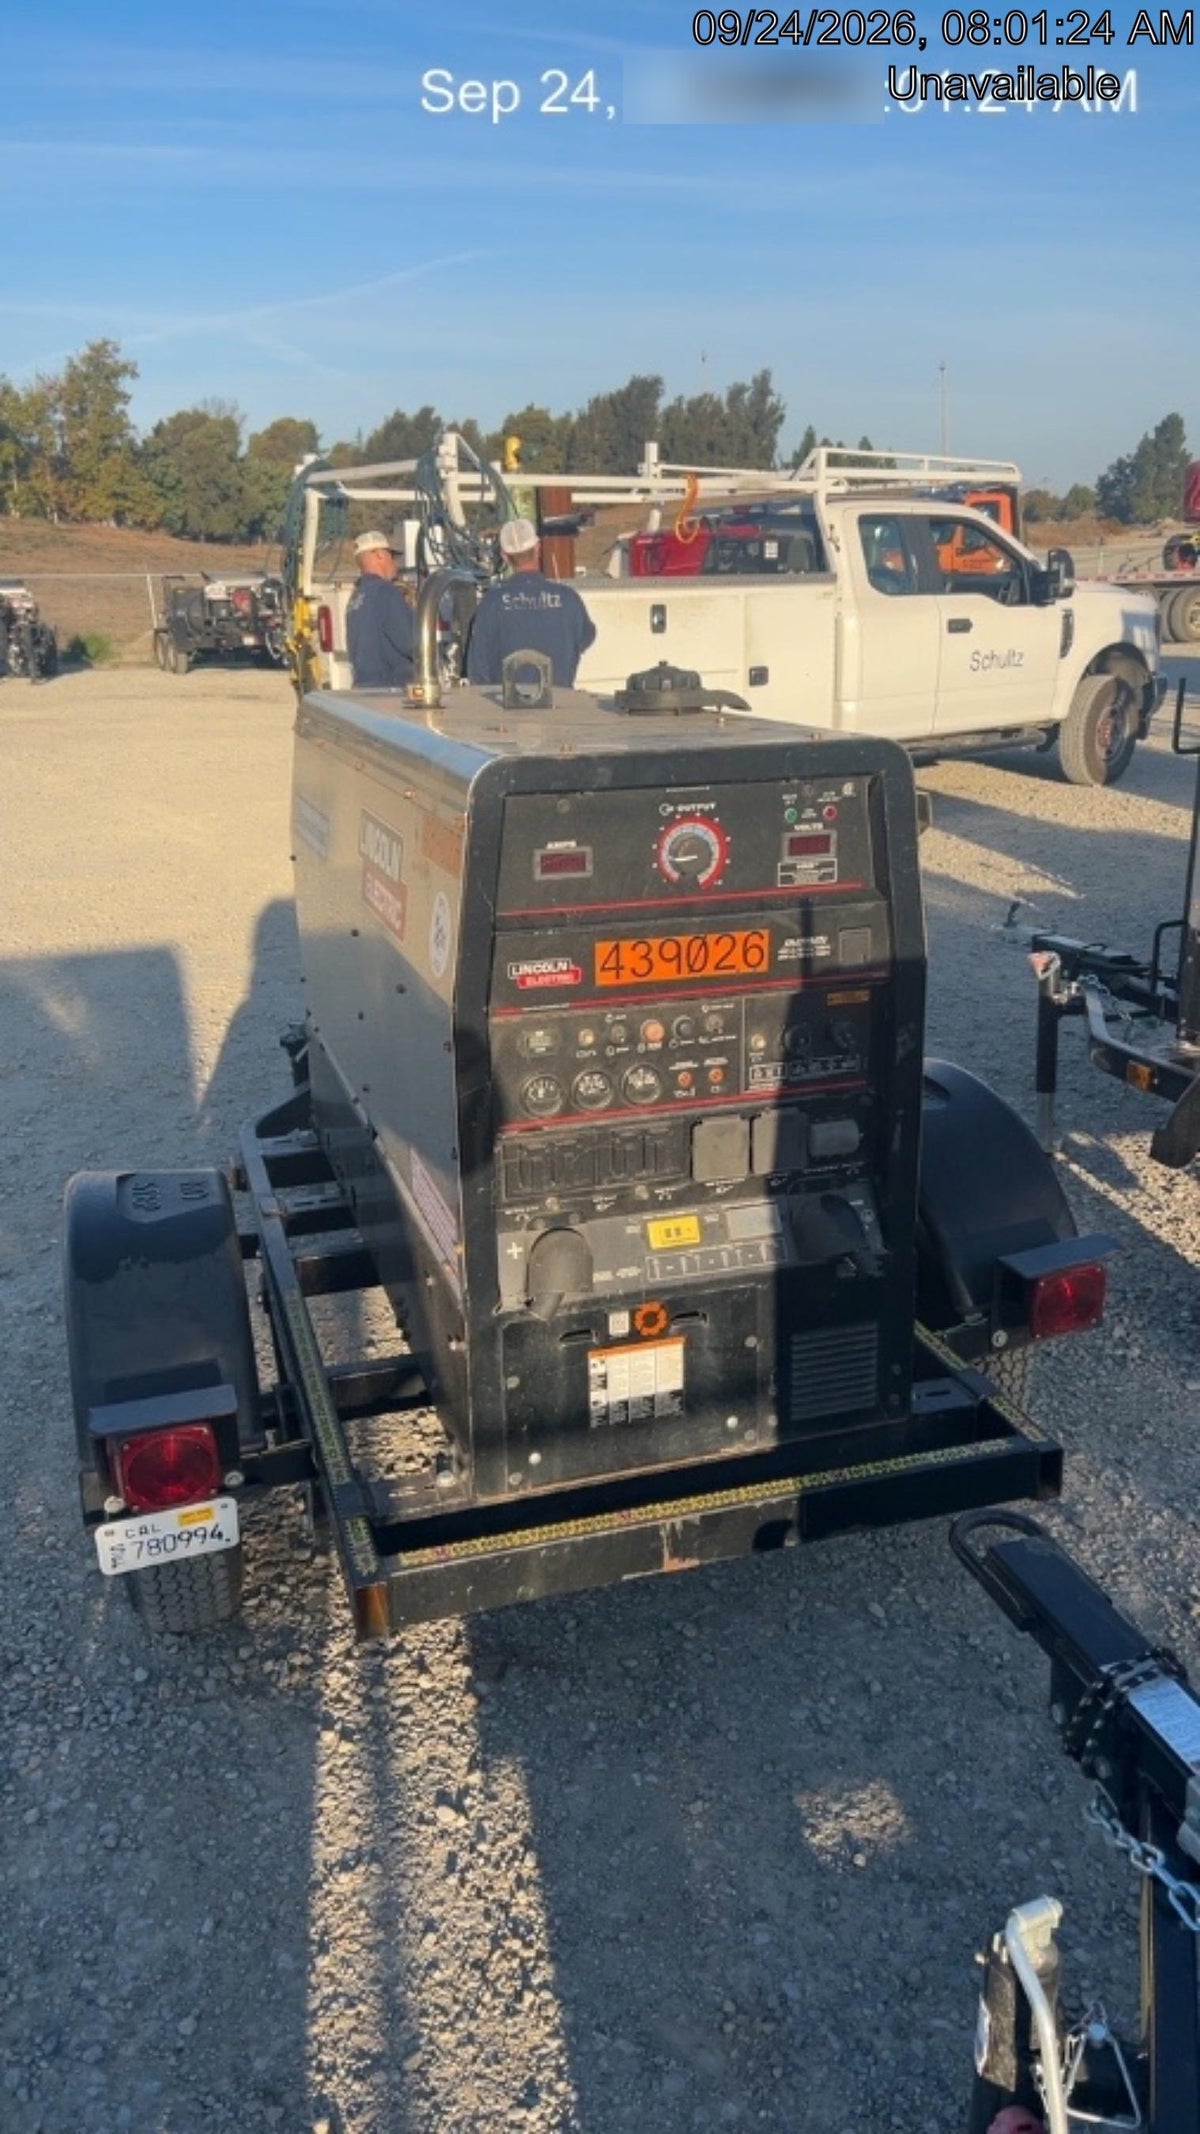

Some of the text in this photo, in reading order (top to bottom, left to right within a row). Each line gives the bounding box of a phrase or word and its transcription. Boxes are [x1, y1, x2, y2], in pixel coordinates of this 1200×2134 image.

[502, 591, 562, 610] Schultz
[970, 649, 1024, 671] Schultz
[600, 930, 765, 980] 439026
[511, 960, 569, 976] LINCOLN
[125, 1524, 162, 1539] CAL
